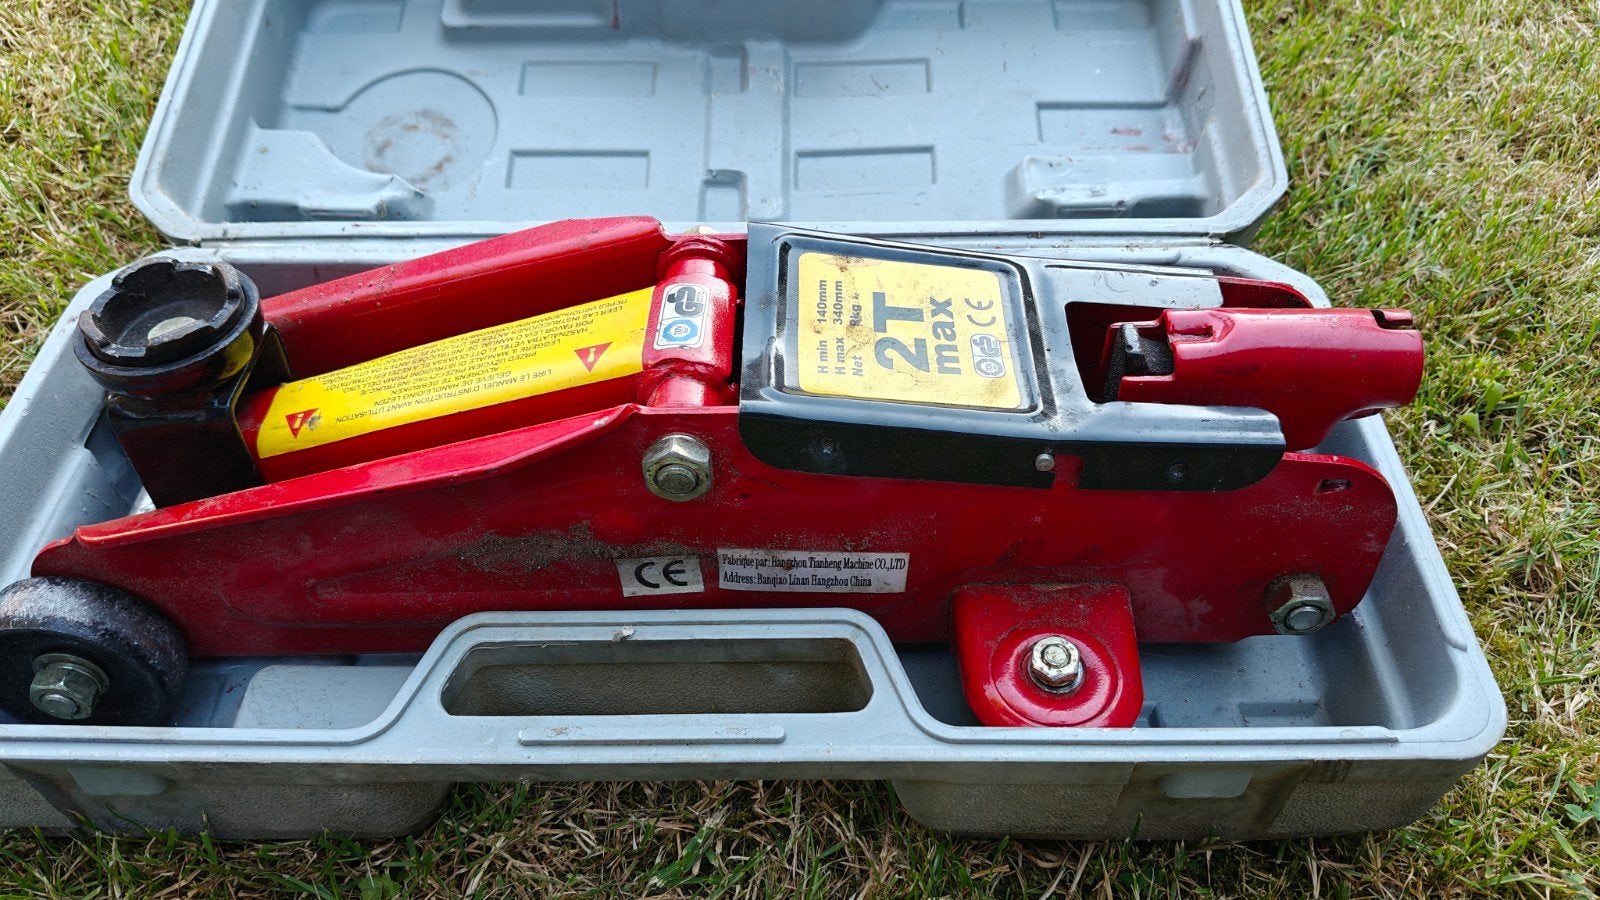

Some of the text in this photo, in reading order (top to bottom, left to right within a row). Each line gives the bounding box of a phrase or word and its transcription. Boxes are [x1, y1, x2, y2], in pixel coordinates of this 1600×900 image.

[817, 279, 828, 324] 140mm
[833, 280, 843, 325] 340mm
[872, 292, 930, 372] 2T
[930, 296, 962, 374] max
[468, 350, 508, 364] MANUALE
[818, 340, 828, 362] min
[836, 337, 845, 362] max
[453, 366, 499, 381] ALVORENS
[519, 373, 530, 381] LE
[531, 368, 551, 378] LIRE
[481, 376, 517, 390] MANUEL
[722, 554, 754, 568] Fabrique
[808, 556, 842, 571] Tianheng
[843, 558, 874, 570] Machine
[757, 572, 788, 588] Banqiao
[788, 574, 810, 586] Linan
[811, 574, 848, 588] Hangzhou
[850, 576, 872, 586] China
